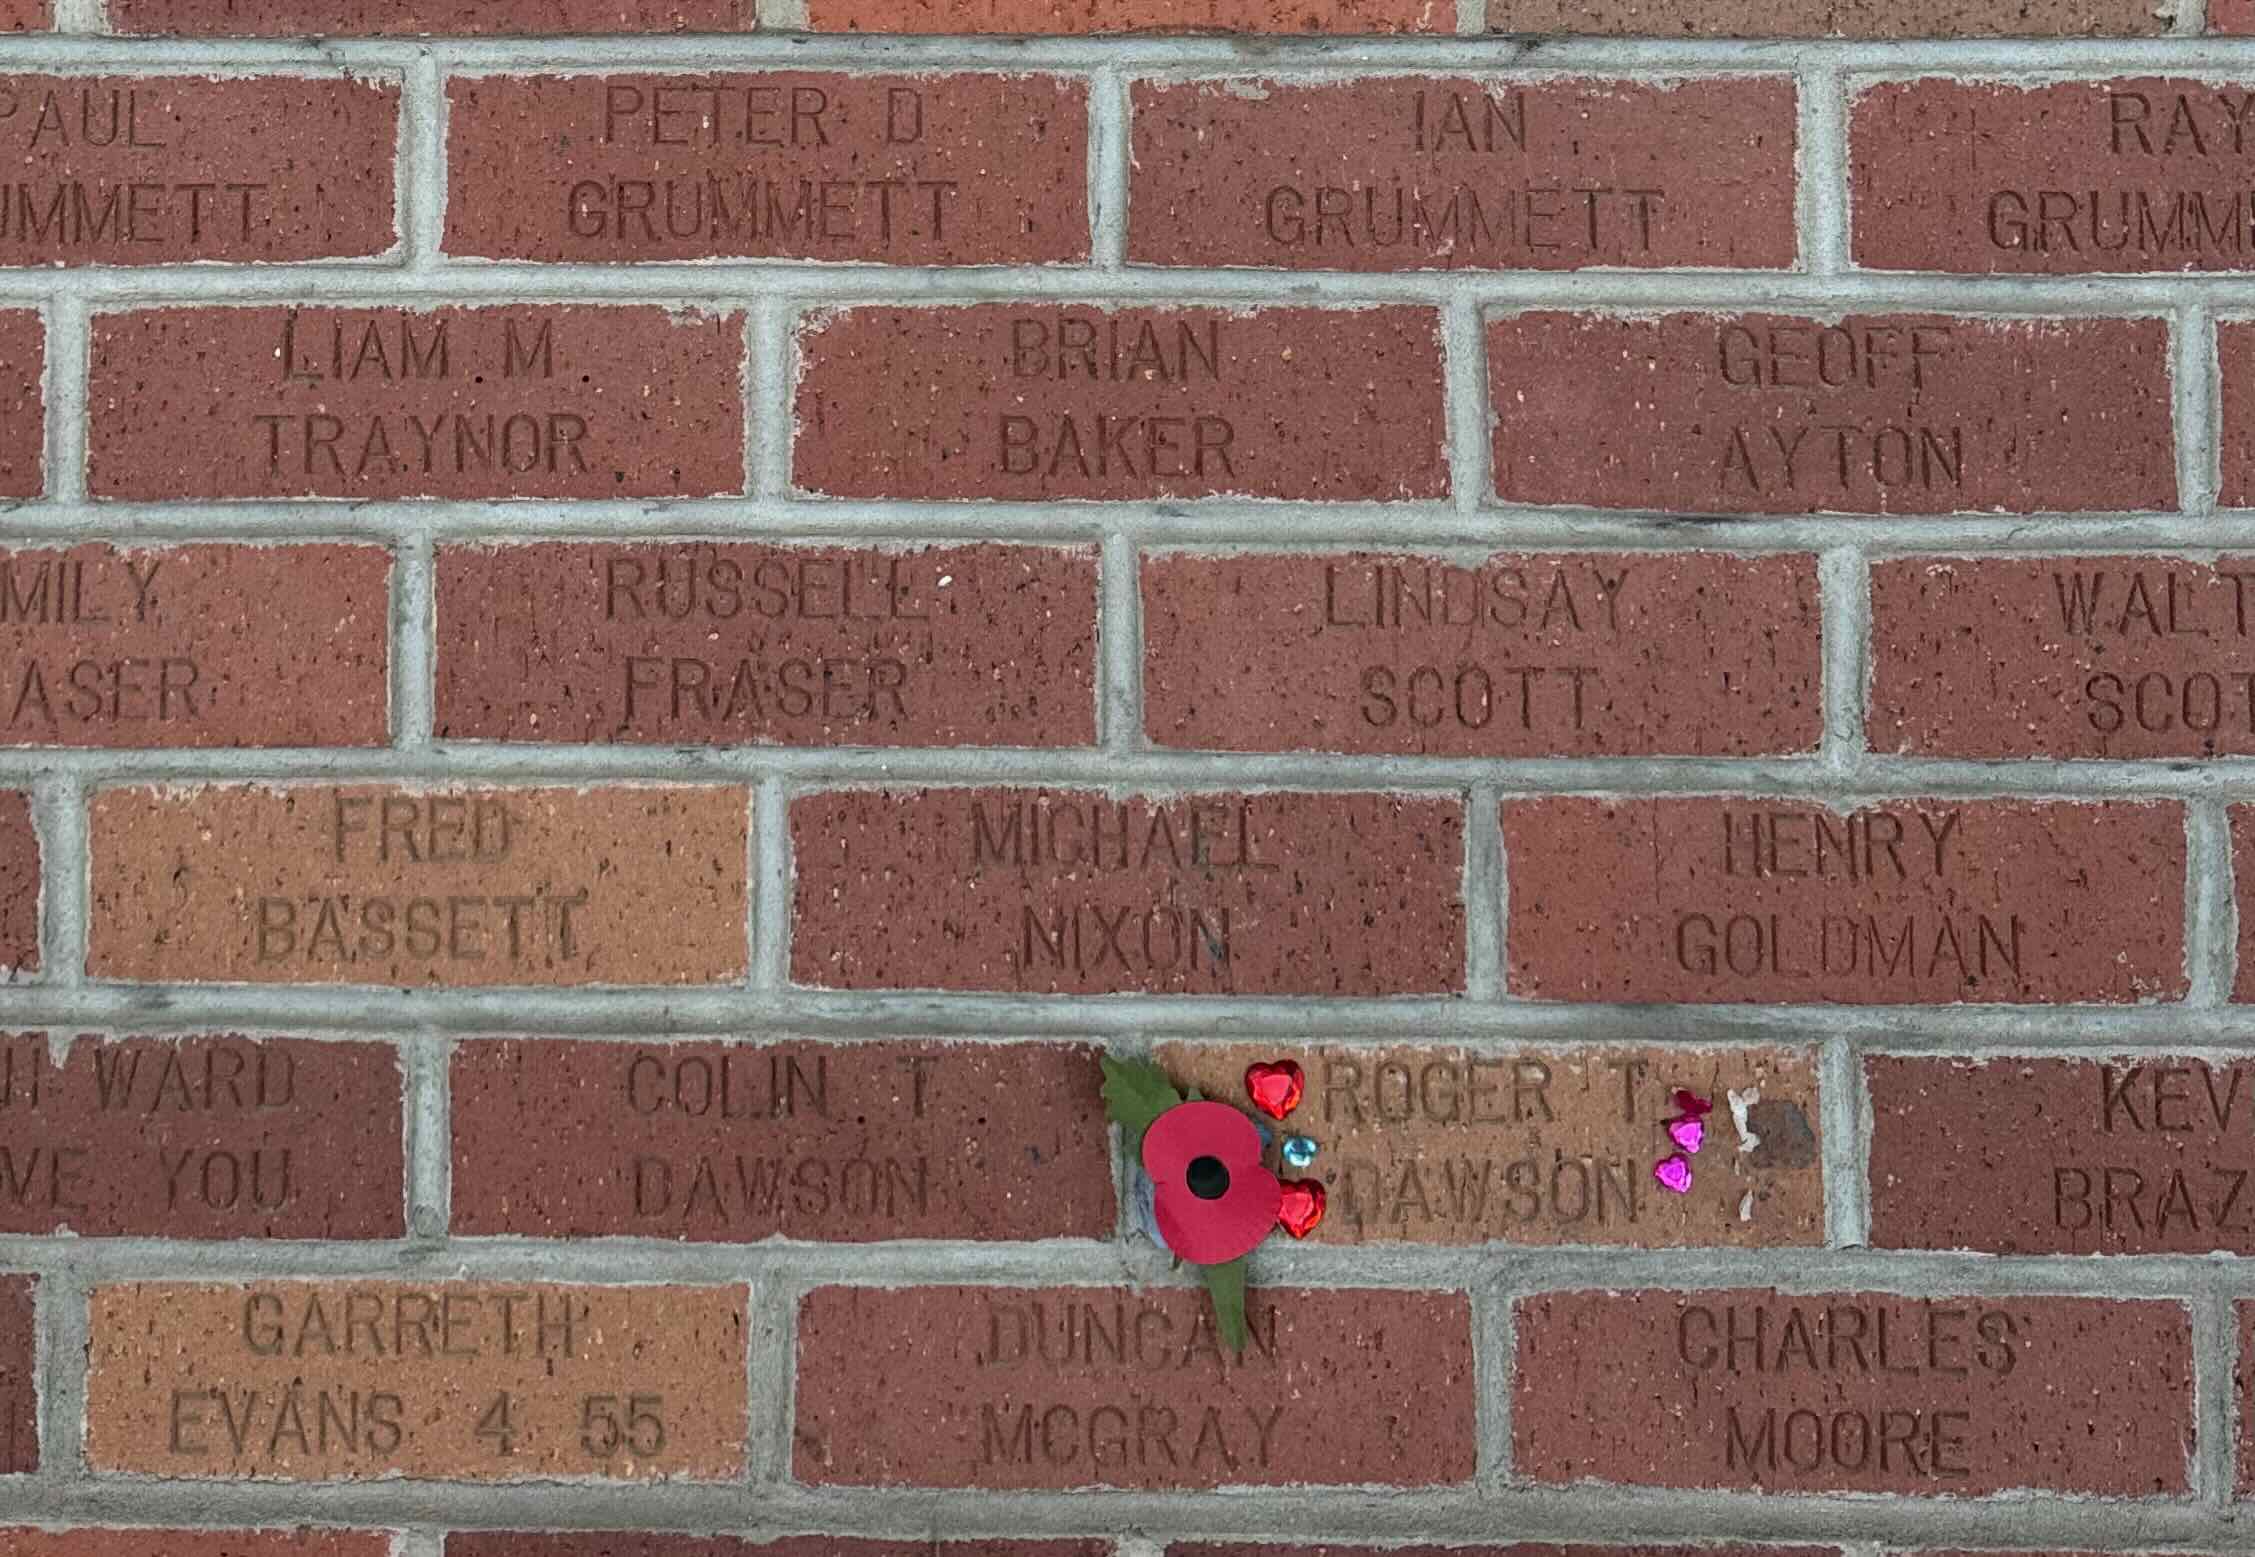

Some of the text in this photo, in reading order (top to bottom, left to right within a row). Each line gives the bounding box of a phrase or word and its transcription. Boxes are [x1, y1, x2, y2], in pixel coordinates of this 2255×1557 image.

[604, 86, 924, 146] PETER D
[1414, 90, 1528, 153] IAN
[2110, 92, 2255, 156] RAY
[0, 183, 268, 246] MMETT
[567, 178, 958, 241] GRUMMETT
[1265, 184, 1666, 252] GRUMMETT
[1987, 190, 2255, 252] GRUMM
[281, 315, 554, 381] LIAM M
[1010, 318, 1221, 381] BRIAN
[1717, 325, 1952, 389] GEOFF
[254, 413, 589, 475] TRAYNOR
[1000, 414, 1236, 479] BAKER
[1717, 424, 1963, 491] AYTON
[0, 560, 161, 624] MILY
[605, 557, 930, 621] RUSSELL
[1325, 565, 1629, 631] LINDSAY
[2052, 572, 2255, 637] WALT
[6, 658, 200, 728] ASER
[624, 655, 909, 721] FRASER
[1361, 664, 1599, 729] SCOTT
[334, 796, 514, 864] FRED
[971, 802, 1280, 871] MICHAEL
[1722, 811, 1960, 880] HENRY
[257, 893, 590, 962] BASSETT
[1022, 904, 1232, 970] NIXON
[1675, 913, 2022, 978] GOLDMAN
[95, 1048, 296, 1111] WARD
[627, 1054, 939, 1119] COLIN T
[1323, 1057, 1649, 1123] ROGER T
[2101, 1066, 2243, 1132] KEV
[0, 1146, 289, 1212] VE YOU
[632, 1154, 929, 1221] DAWSON
[1342, 1158, 1639, 1225] DAWSON
[2055, 1167, 2249, 1233] BRAZ
[242, 1292, 577, 1359] GARRETH
[988, 1302, 1277, 1369] DUNCAN
[1678, 1305, 2018, 1376] CHARLES
[170, 1390, 667, 1458] EVANS 4 55
[980, 1404, 1285, 1470] MCGRAY
[1726, 1407, 1971, 1477] MOORE
